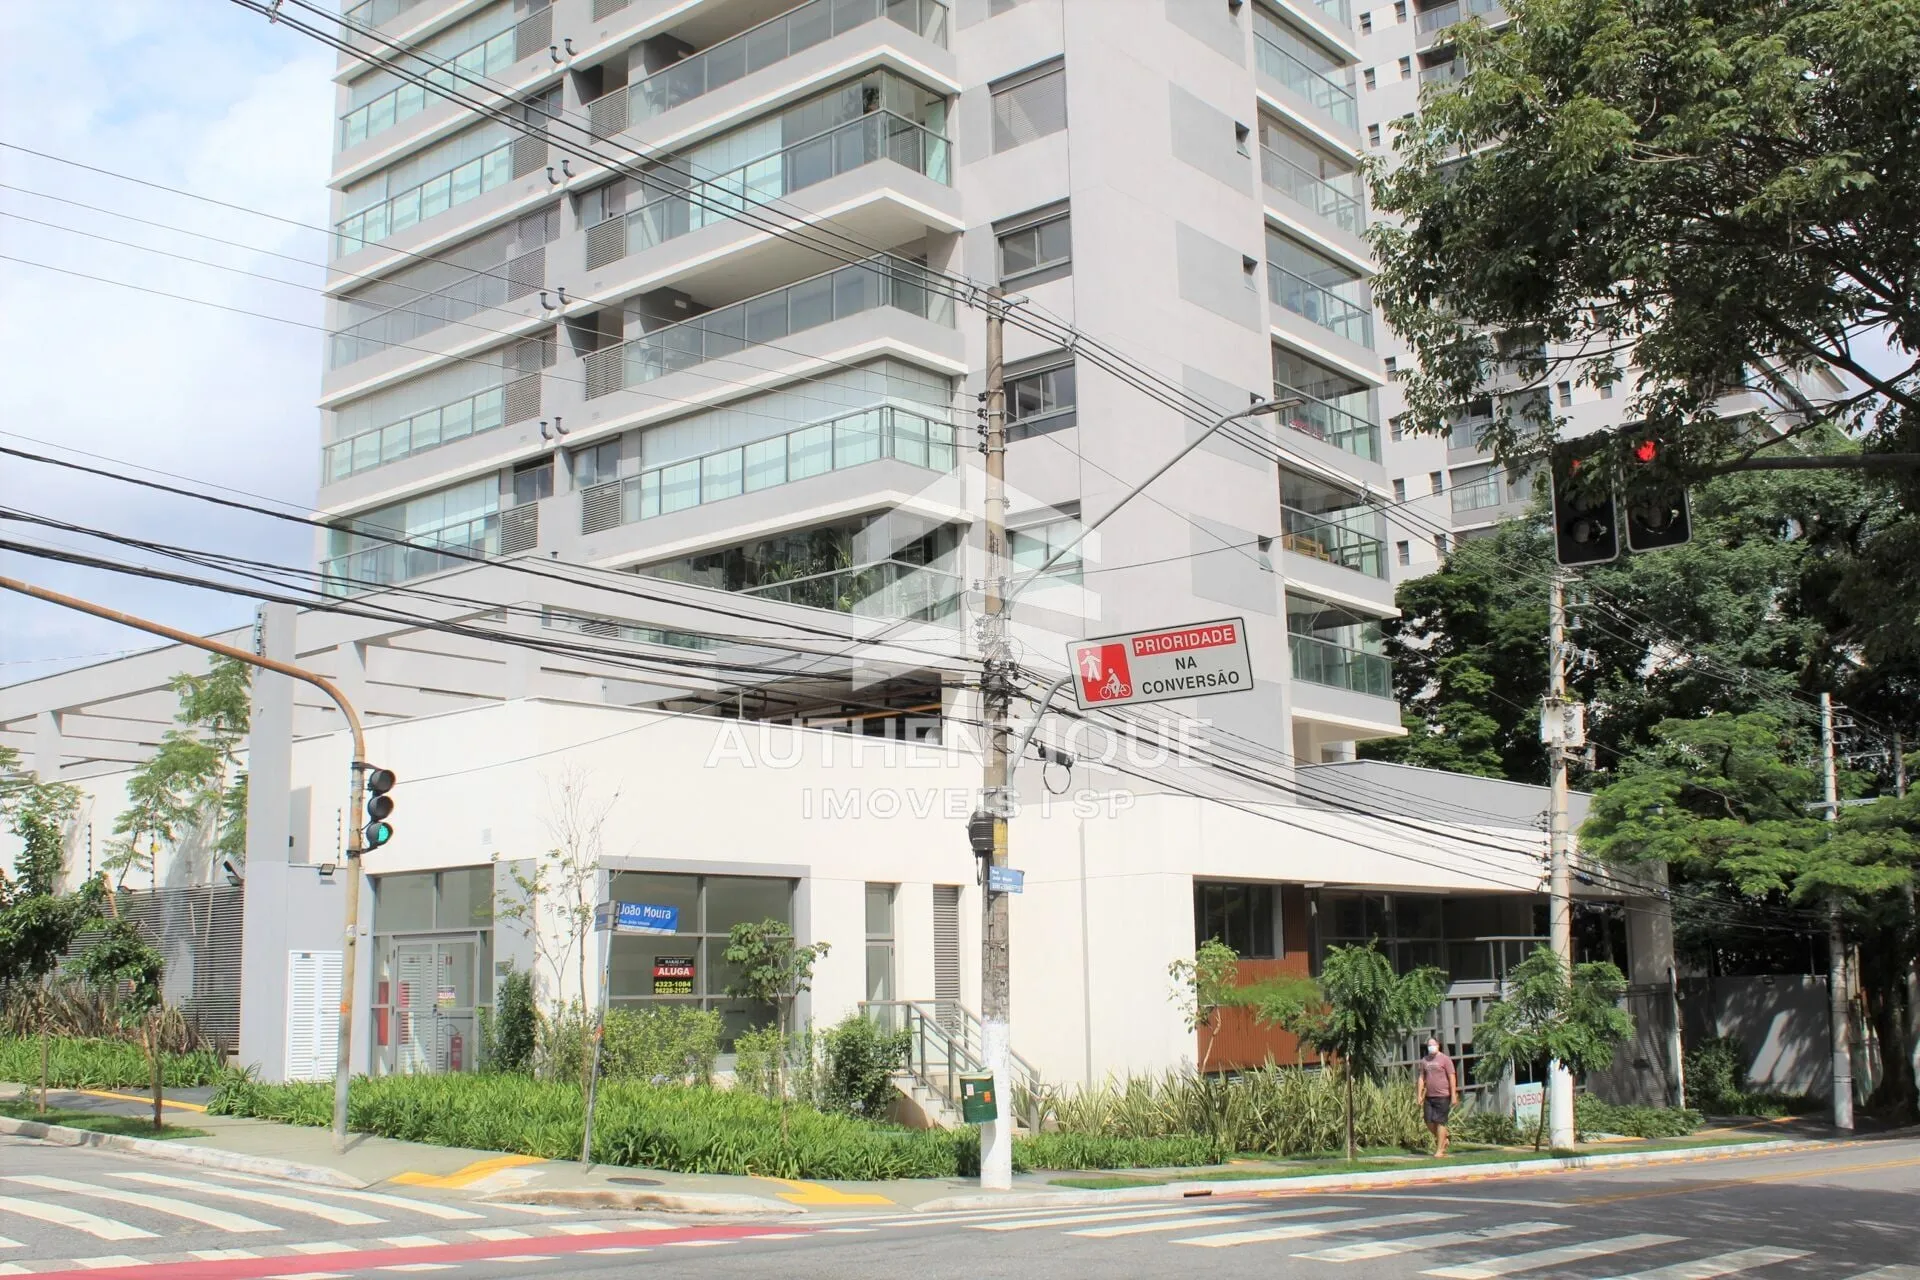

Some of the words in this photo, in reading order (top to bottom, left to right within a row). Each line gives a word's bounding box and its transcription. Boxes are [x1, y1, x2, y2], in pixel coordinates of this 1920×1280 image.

[1135, 627, 1234, 654] PRIORIDADE
[1175, 655, 1198, 671] NA
[1142, 669, 1240, 695] CONVERSÃO
[620, 903, 641, 916] João
[643, 906, 671, 919] Moura
[658, 967, 690, 976] ALUGA
